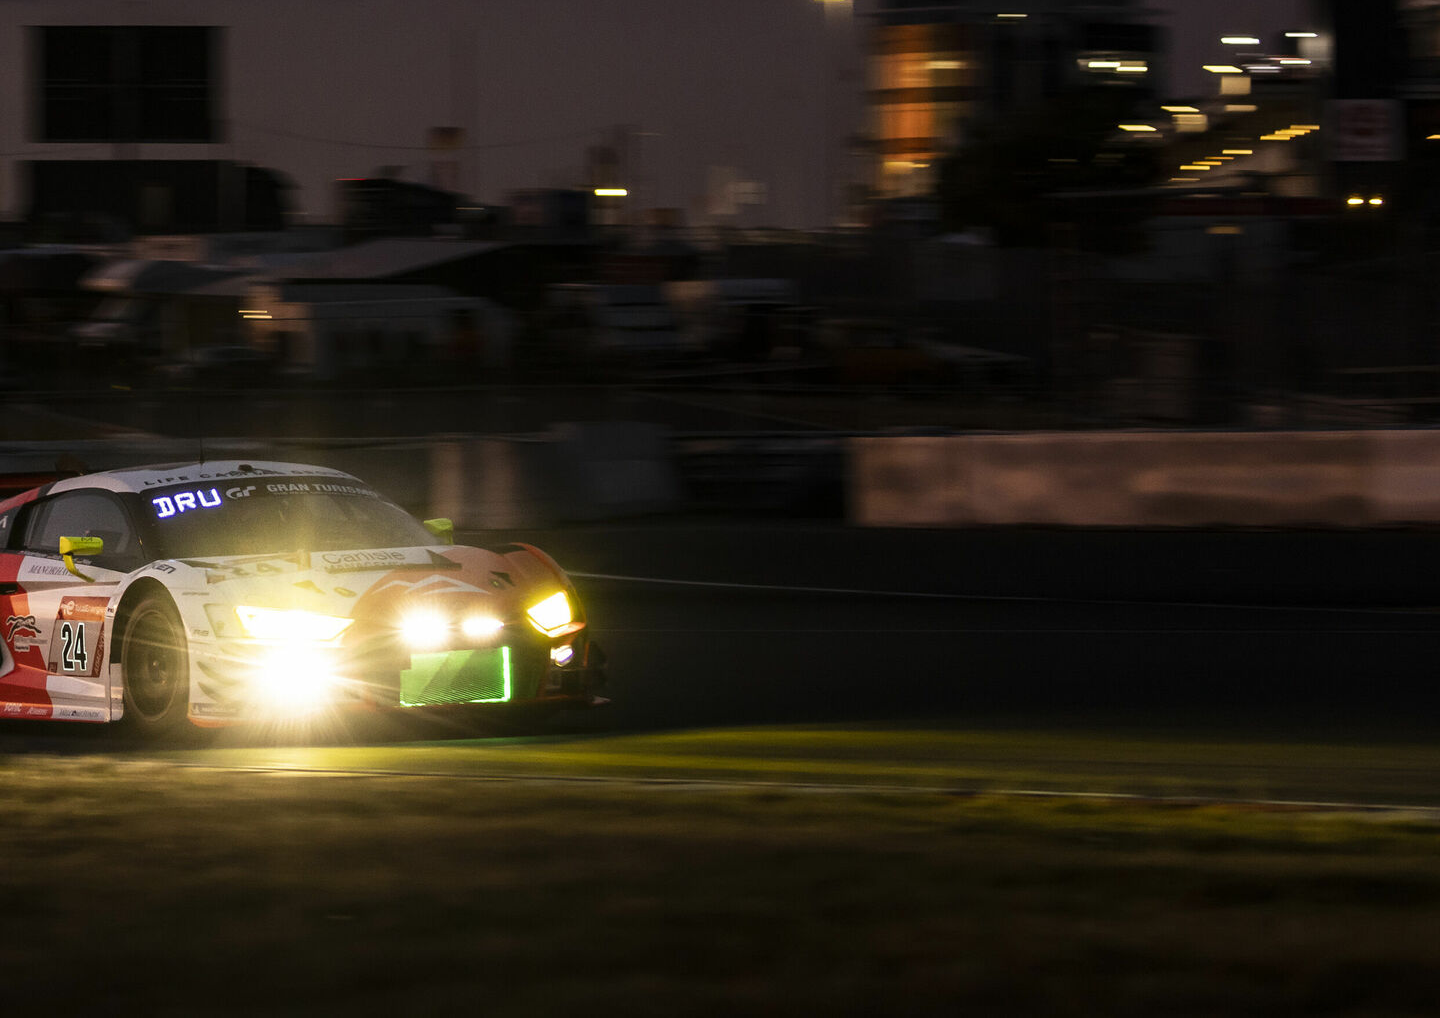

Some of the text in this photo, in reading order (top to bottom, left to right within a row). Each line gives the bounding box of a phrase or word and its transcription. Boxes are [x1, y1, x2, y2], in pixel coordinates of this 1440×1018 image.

[266, 483, 310, 494] GRAN
[152, 488, 222, 518] DRU
[321, 549, 406, 564] Carlisle
[61, 621, 88, 672] 24
